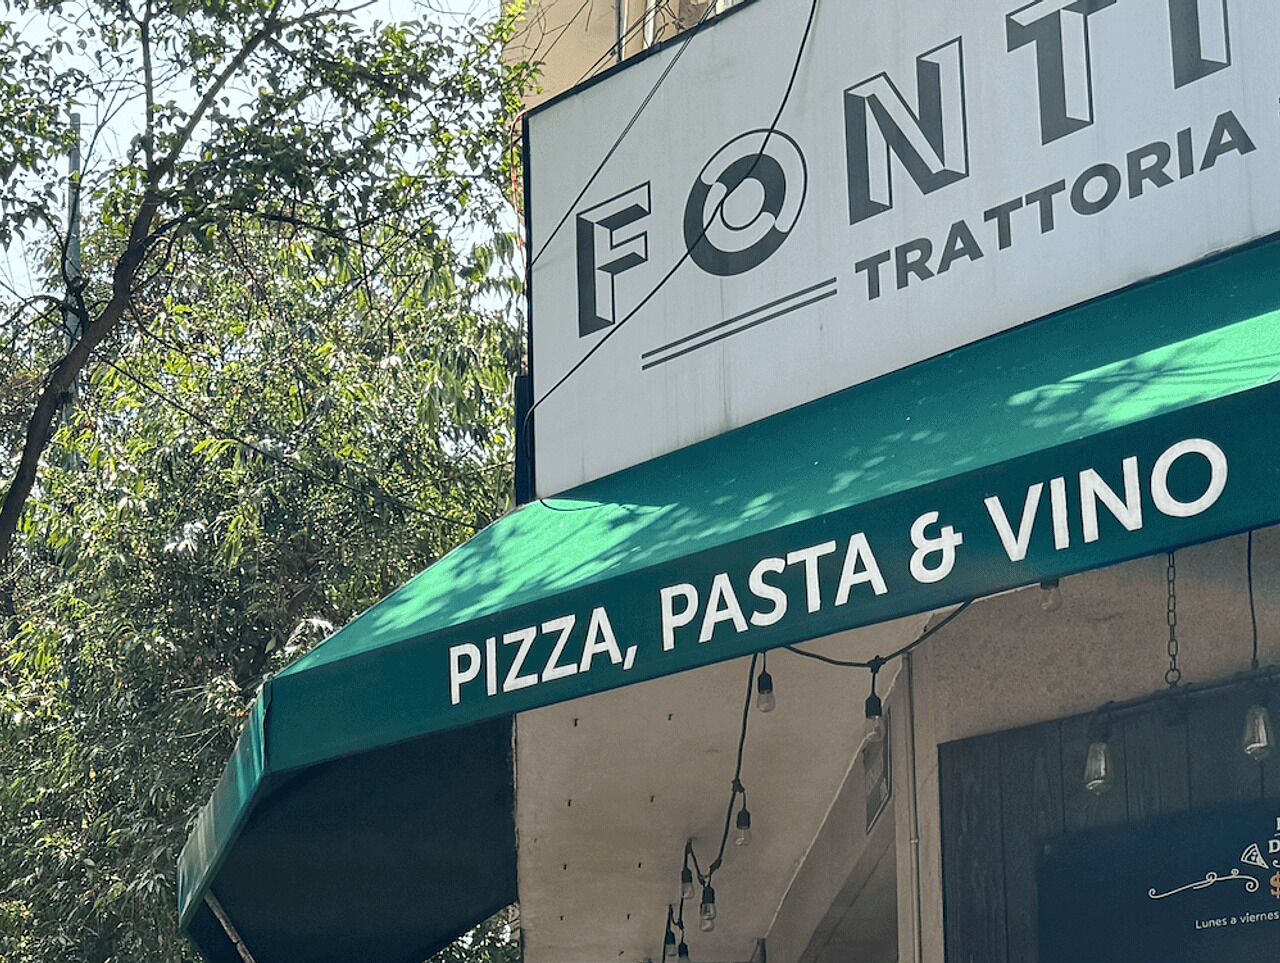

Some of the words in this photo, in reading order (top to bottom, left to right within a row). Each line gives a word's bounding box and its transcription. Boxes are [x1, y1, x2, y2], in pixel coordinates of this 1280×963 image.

[855, 110, 1257, 300] TRATTORIA
[449, 606, 637, 705] PIZZA,
[660, 531, 888, 651] PASTA
[909, 511, 963, 584] &
[984, 437, 1229, 563] VINO
[1195, 917, 1228, 929] Lunes
[1230, 917, 1237, 925] a
[1240, 911, 1280, 923] viernes
